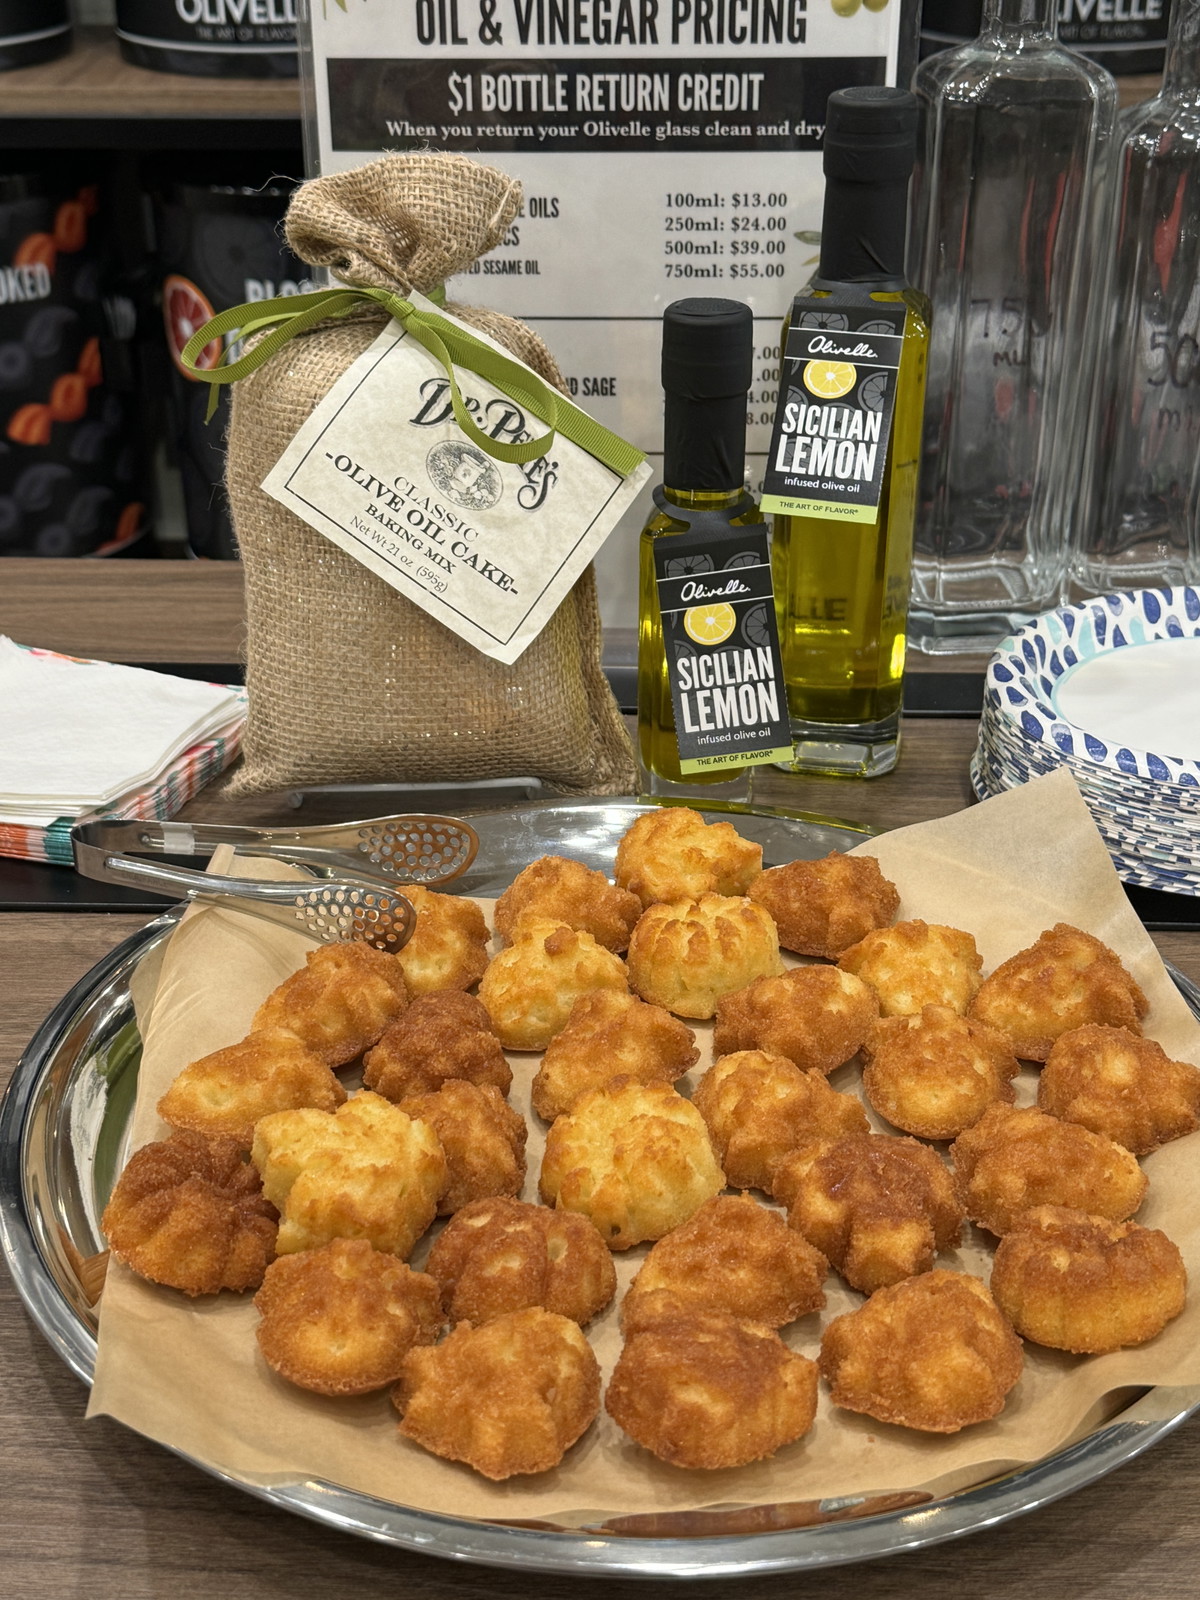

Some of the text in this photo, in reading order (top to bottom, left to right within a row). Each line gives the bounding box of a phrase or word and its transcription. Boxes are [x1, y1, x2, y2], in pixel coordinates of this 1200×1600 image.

[416, 0, 807, 46] OIL & VINEGAR PRICING
[448, 71, 765, 116] $1 BOTTLE RETURN CREDIT
[386, 120, 827, 141] When you return your Olivelle glass clean and dry
[529, 197, 560, 218] OILS
[665, 192, 787, 209] 100ml: $13.00
[664, 216, 787, 233] 250ml: $24.00
[664, 240, 786, 256] 500ml: $39.00
[483, 259, 523, 275] SESAME
[525, 259, 541, 275] OIL
[664, 263, 785, 279] 750ml: $55.00
[807, 335, 878, 359] Olivelle
[582, 376, 617, 397] SAGE
[781, 402, 883, 443] SICILIAN
[775, 434, 878, 482] LEMON
[784, 476, 860, 493] infused olive oil
[394, 476, 479, 543] CLASSIC
[779, 501, 794, 509] THE
[795, 502, 811, 510] ART
[812, 504, 823, 512] OF
[406, 509, 447, 546] OIL
[364, 503, 457, 575] BAKING MIX
[350, 515, 449, 594] Net Wt 21 oz (595g)
[680, 579, 751, 602] Olivelle
[677, 645, 775, 691] SICILIAN
[680, 680, 780, 734] LEMON
[697, 726, 771, 745] infused olive oil
[696, 758, 711, 767] THE
[712, 756, 728, 765] ART
[729, 754, 740, 763] OF
